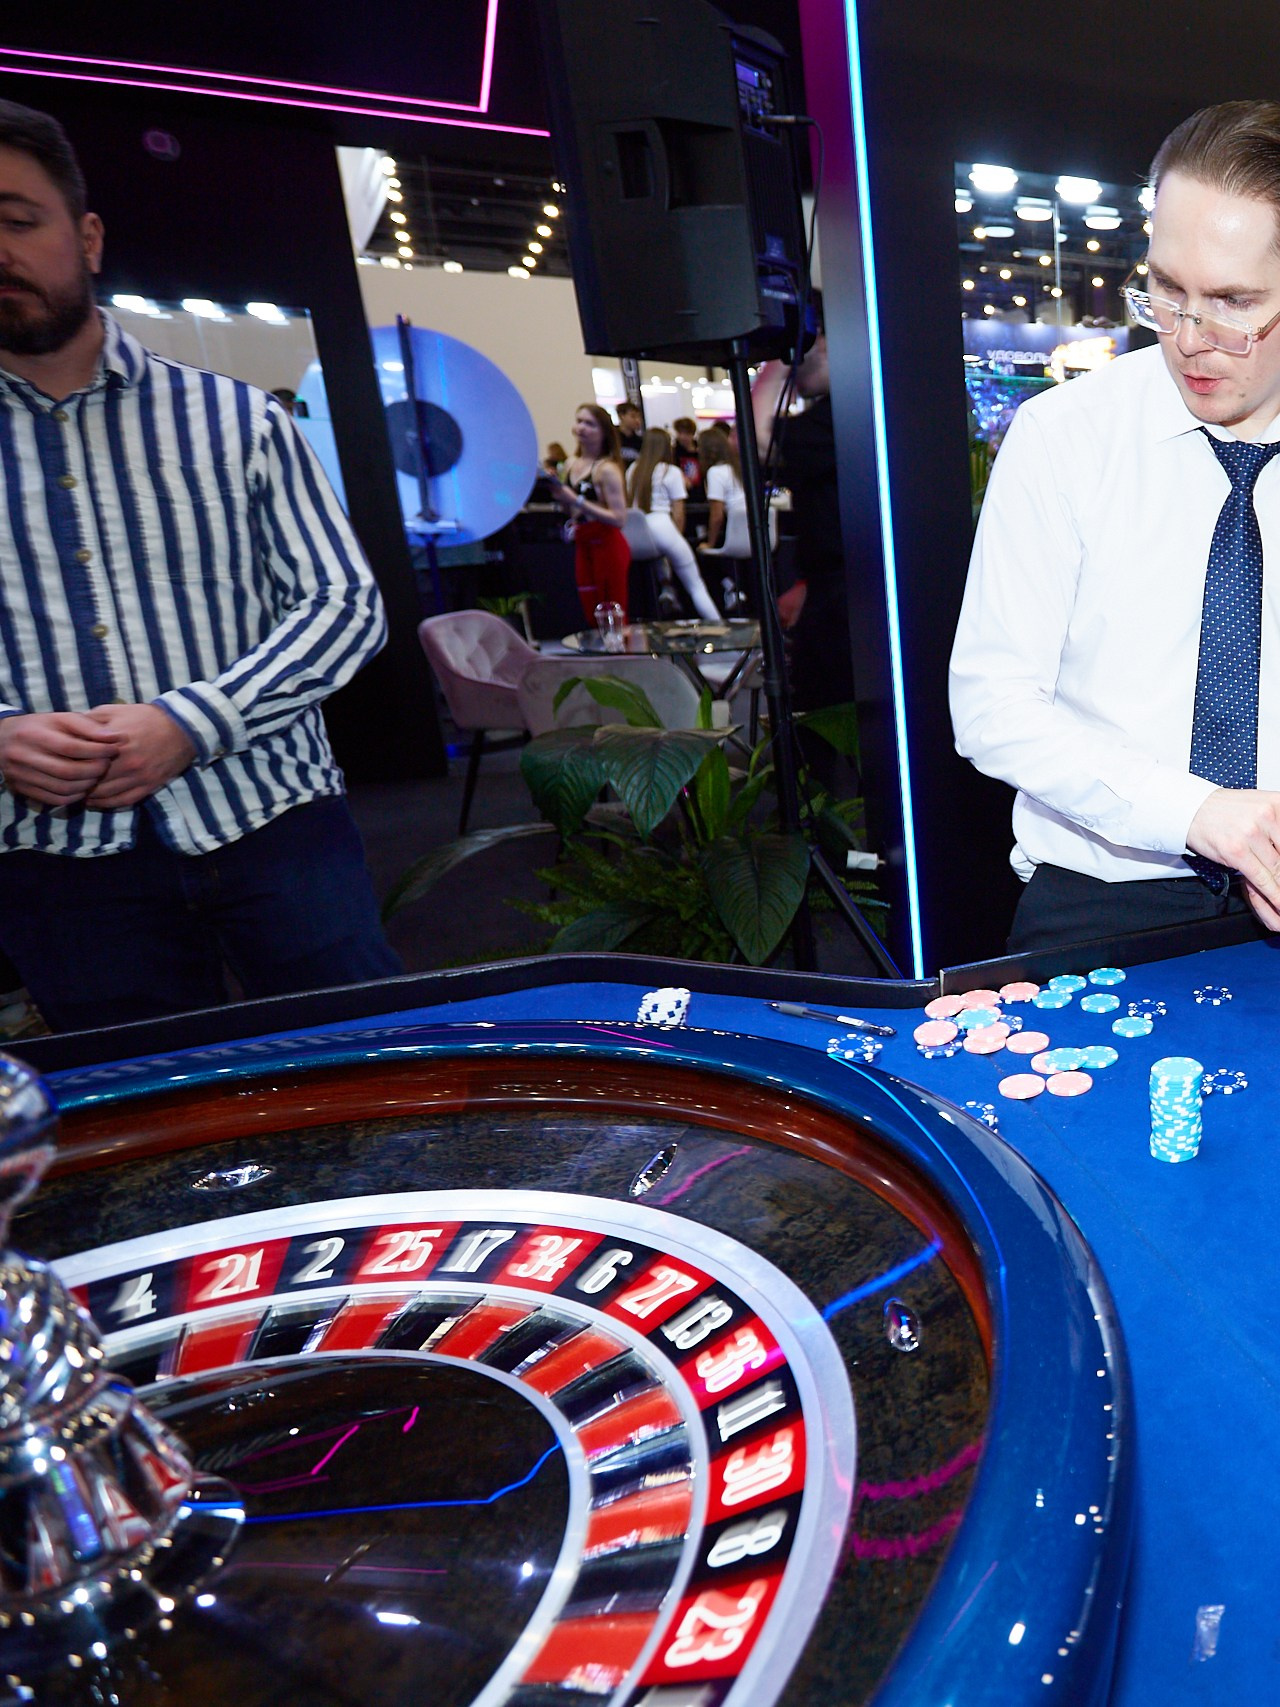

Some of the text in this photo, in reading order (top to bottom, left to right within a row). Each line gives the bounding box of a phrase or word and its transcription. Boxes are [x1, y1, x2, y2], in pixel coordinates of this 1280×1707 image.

[202, 1248, 265, 1300] 21
[298, 1236, 347, 1284] 2
[364, 1229, 444, 1276] 25
[440, 1228, 518, 1274] 17
[512, 1234, 584, 1283] 34
[579, 1248, 635, 1295] 6
[117, 1272, 158, 1321] 4
[618, 1266, 699, 1320] 27
[661, 1296, 734, 1350] 13
[697, 1330, 768, 1394] 36
[717, 1384, 787, 1443] 11
[721, 1436, 794, 1507] 30
[707, 1516, 785, 1568] 8
[664, 1592, 760, 1669] 23
